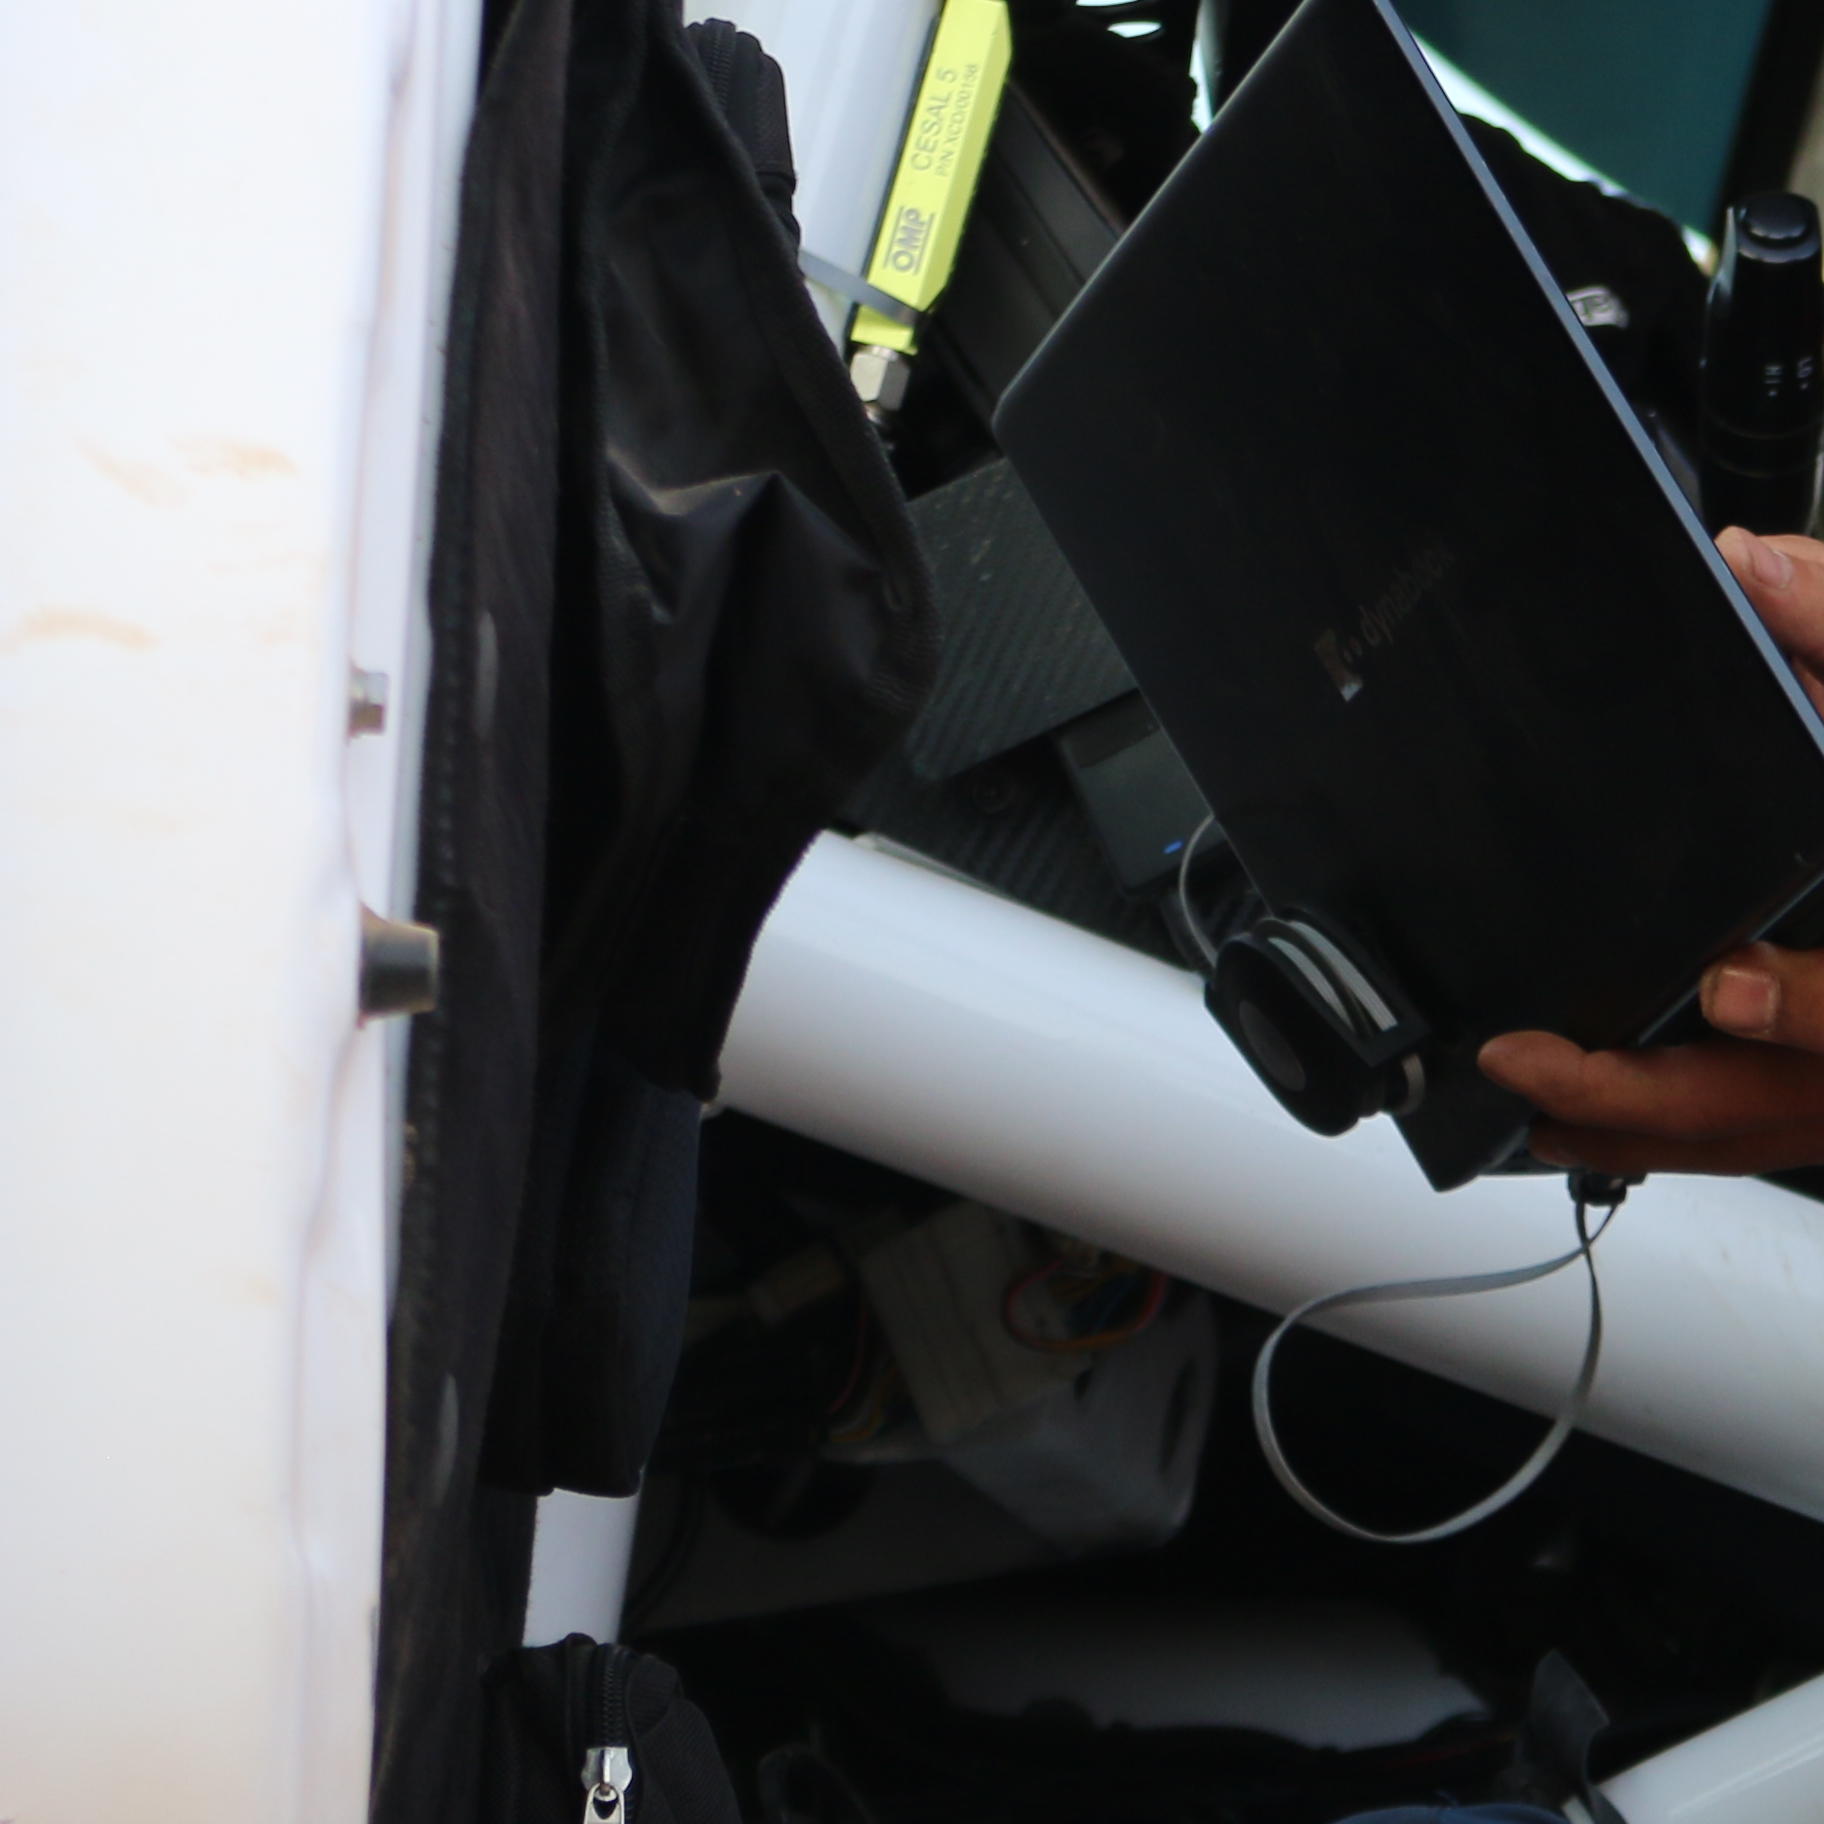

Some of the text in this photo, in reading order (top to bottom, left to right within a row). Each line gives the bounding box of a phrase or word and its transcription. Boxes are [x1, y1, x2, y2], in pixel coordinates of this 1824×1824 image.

[910, 66, 958, 172] CESAL 5
[890, 206, 930, 273] OMP
